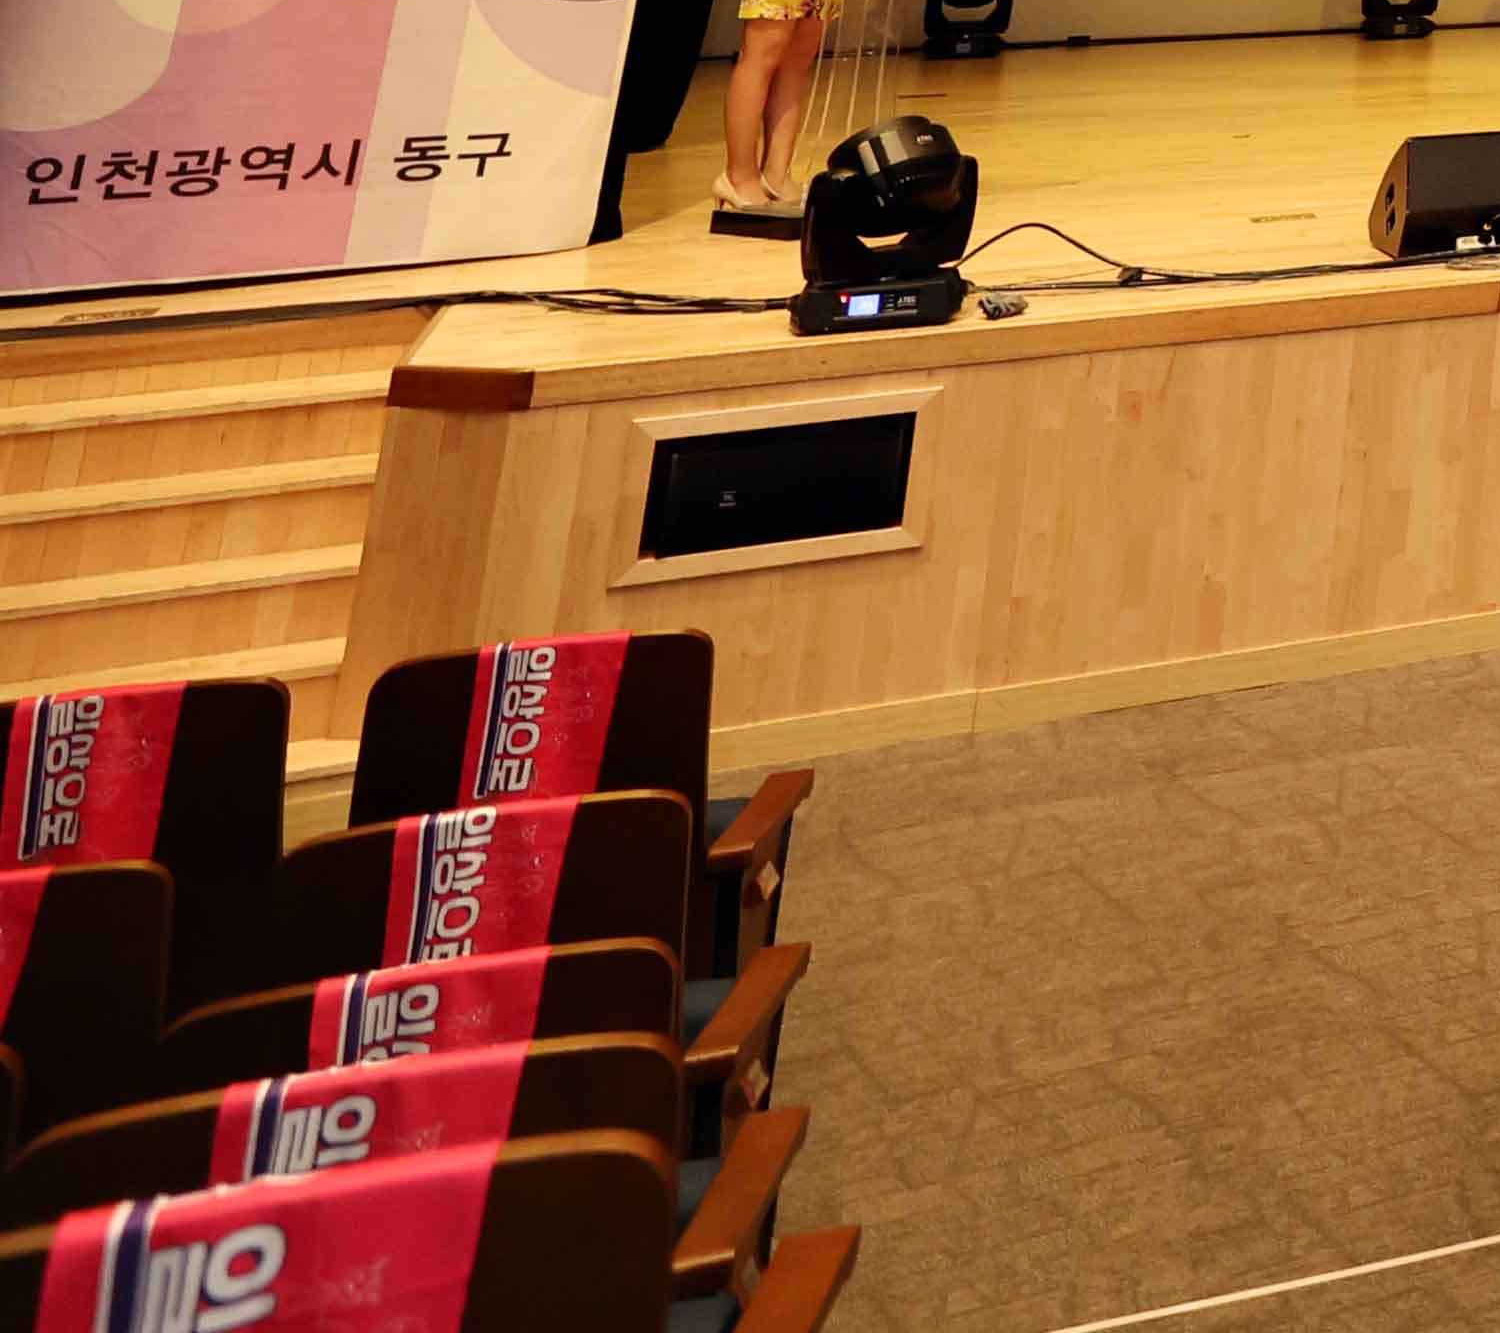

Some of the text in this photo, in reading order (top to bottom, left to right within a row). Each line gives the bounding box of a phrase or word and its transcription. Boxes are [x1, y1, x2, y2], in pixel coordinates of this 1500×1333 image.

[24, 130, 513, 205] 인천광역시 동구
[38, 694, 105, 848] 일상으로
[488, 646, 557, 794] 일상으로
